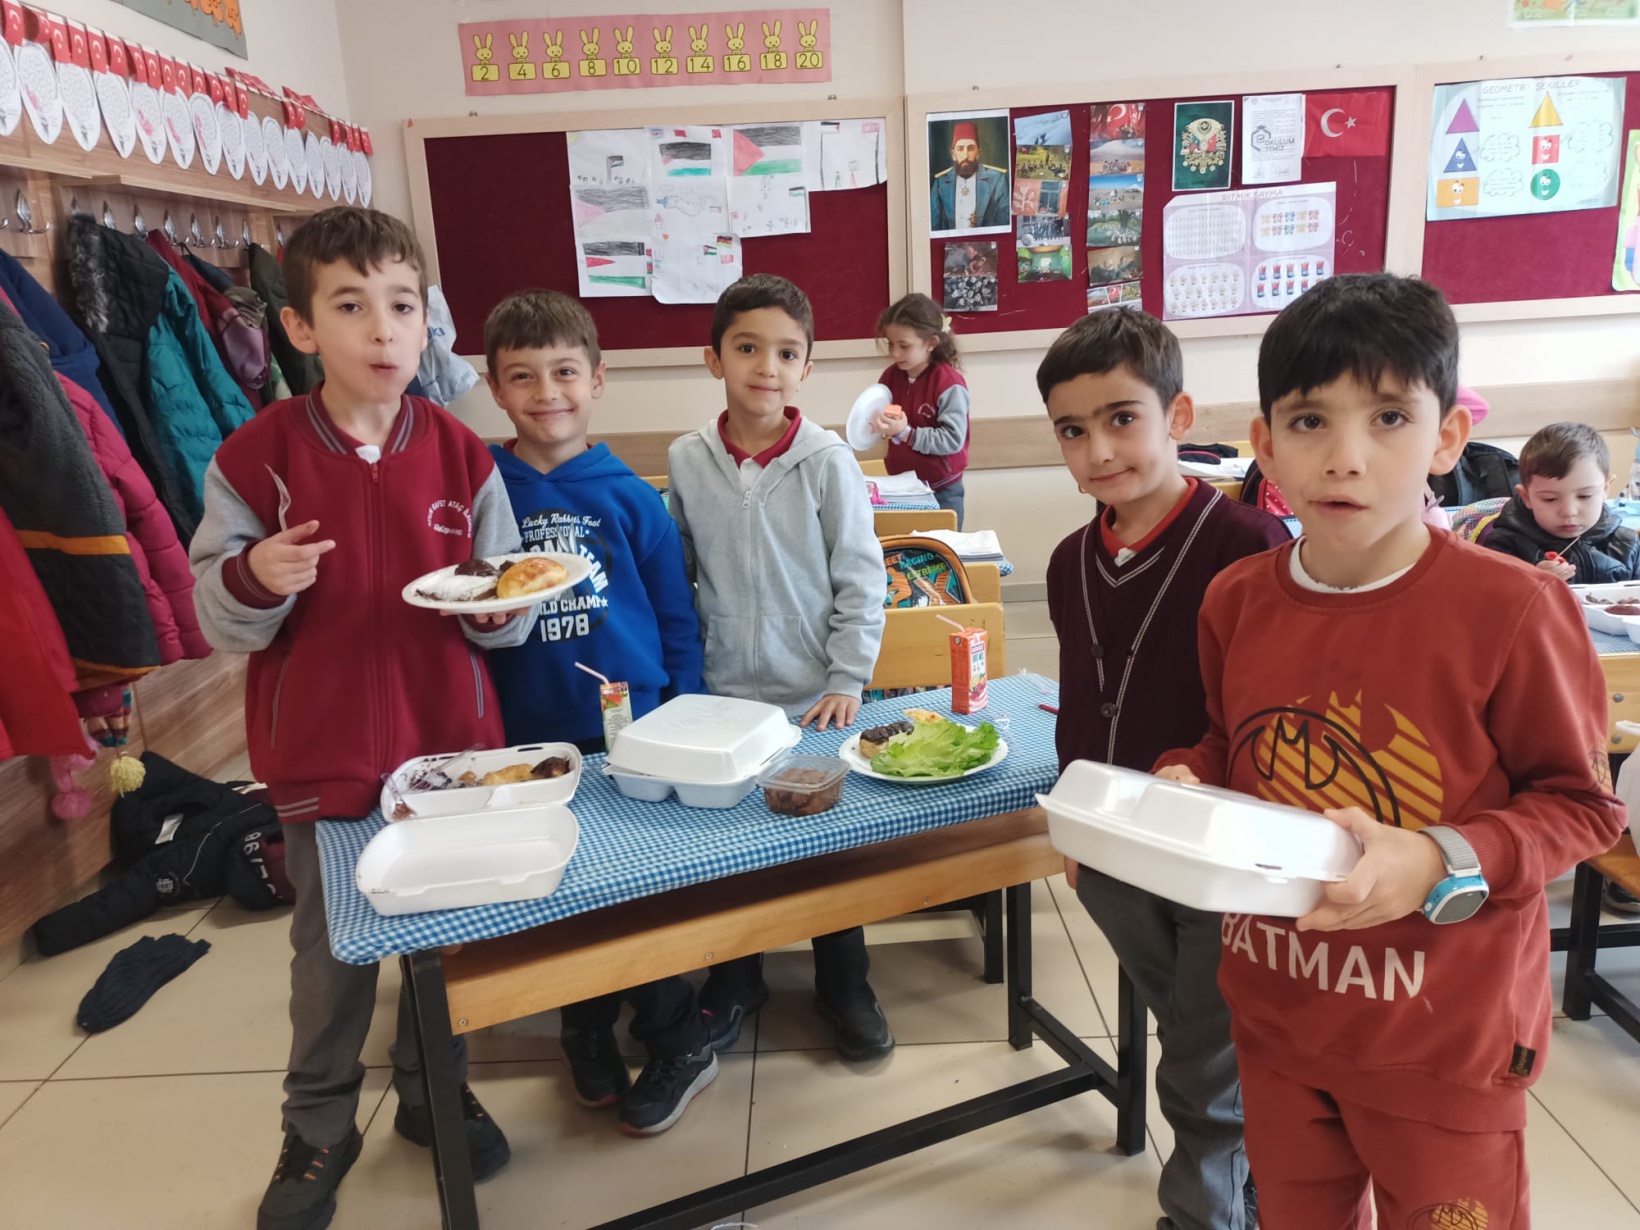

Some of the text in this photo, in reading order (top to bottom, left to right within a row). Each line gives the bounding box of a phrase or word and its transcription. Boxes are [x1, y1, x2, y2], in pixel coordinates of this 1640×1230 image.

[480, 53, 820, 80] 2 4 6 8 10 12 14 16 18 20
[521, 515, 548, 529] Lucky
[580, 543, 608, 593] TEAM
[540, 613, 590, 642] 1978
[1221, 912, 1426, 1002] BATMAN
